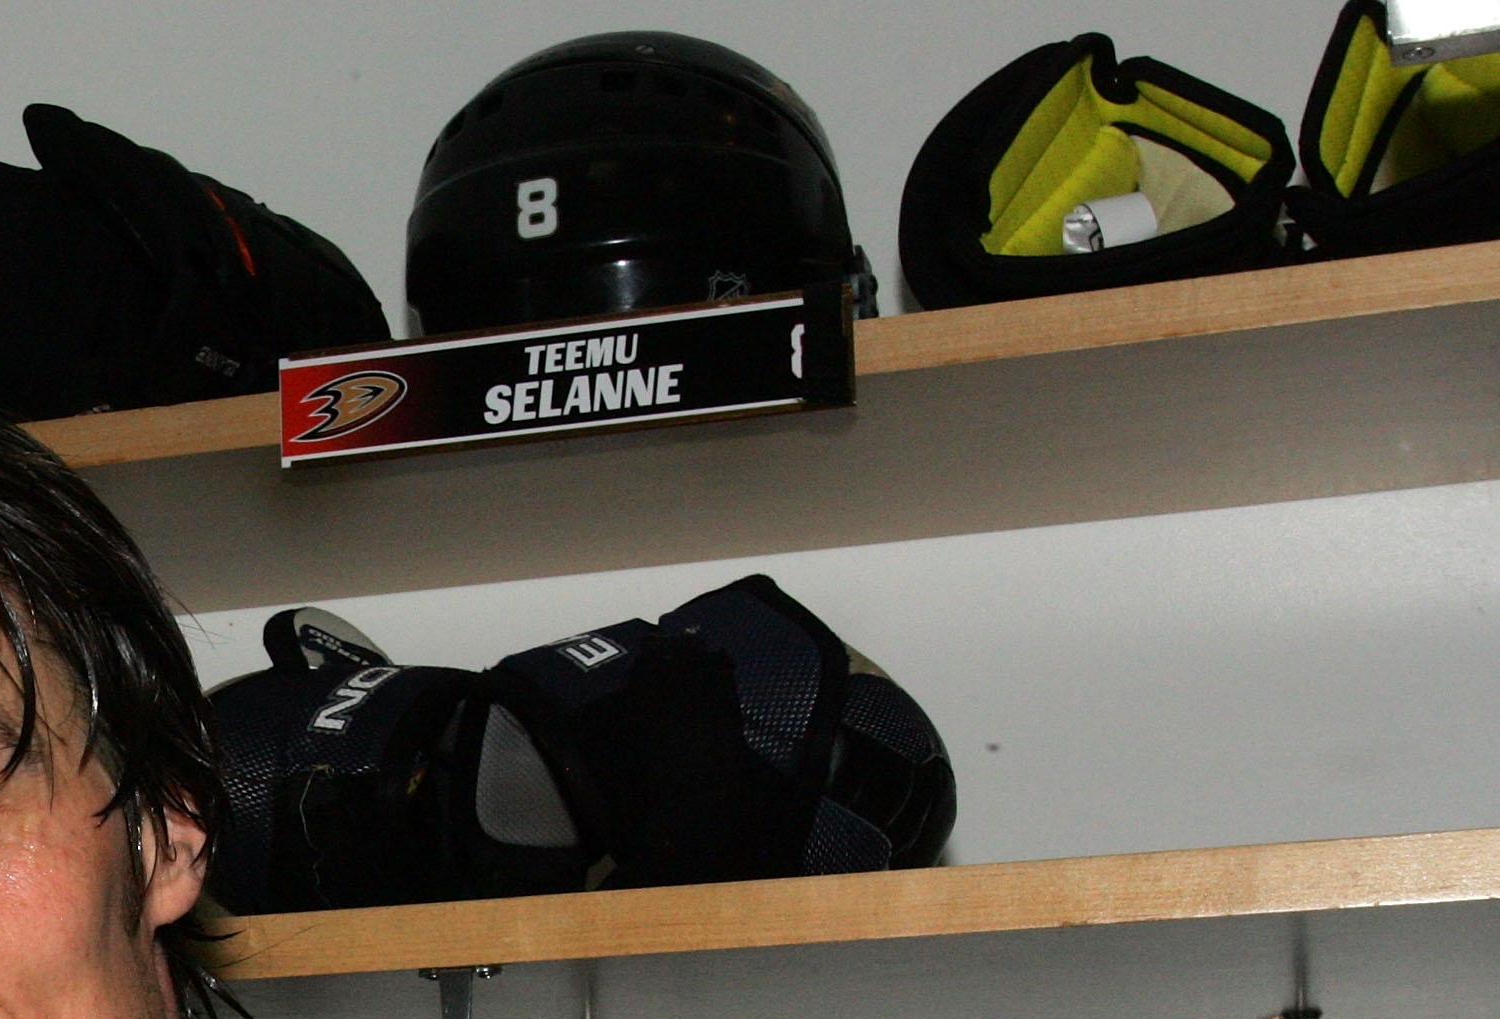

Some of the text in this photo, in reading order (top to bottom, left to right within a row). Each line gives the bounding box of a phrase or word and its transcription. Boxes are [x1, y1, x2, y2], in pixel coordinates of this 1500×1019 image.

[516, 177, 559, 240] 8
[524, 333, 639, 376] TEEMU
[483, 363, 684, 425] SELANNE
